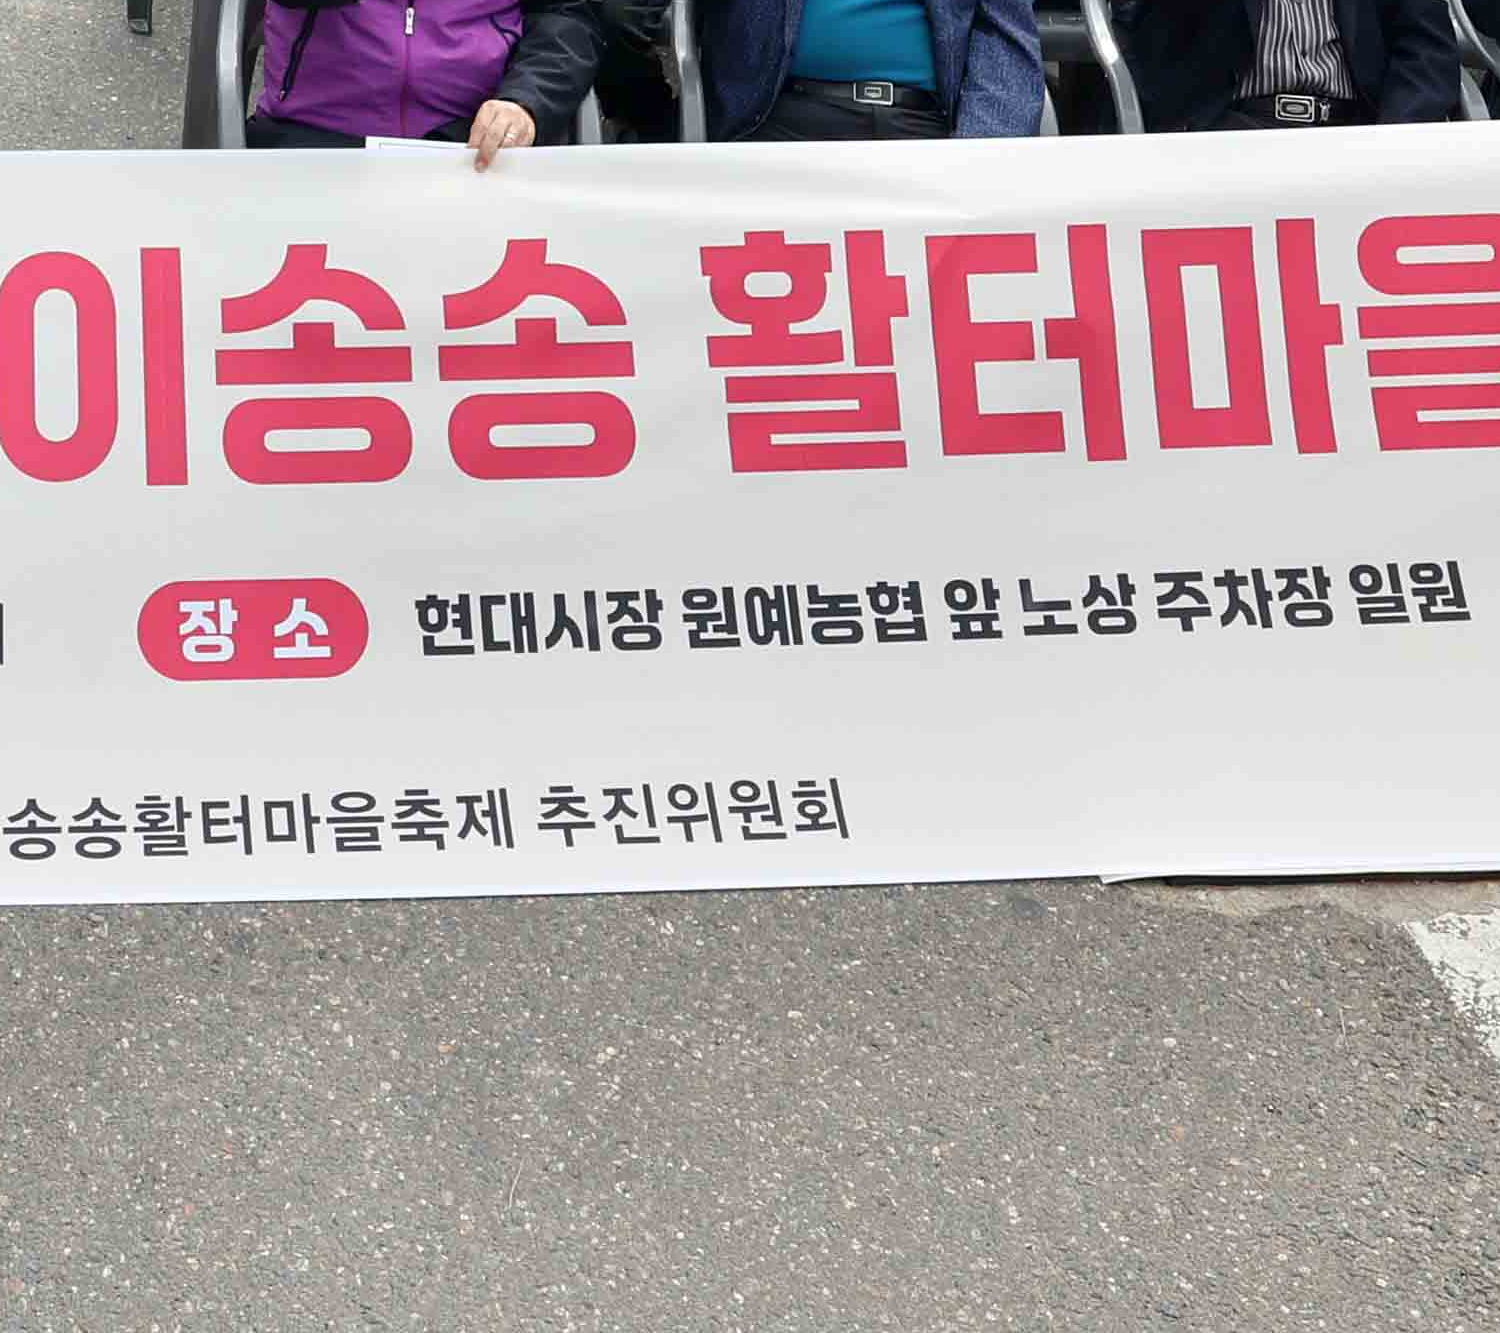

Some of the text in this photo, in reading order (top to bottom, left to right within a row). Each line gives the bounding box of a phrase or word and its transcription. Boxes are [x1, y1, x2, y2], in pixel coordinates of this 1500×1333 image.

[414, 560, 1471, 656] 현대시장 원예농협 앞 노상 주차장 일원
[537, 778, 849, 847] 추진위원회
